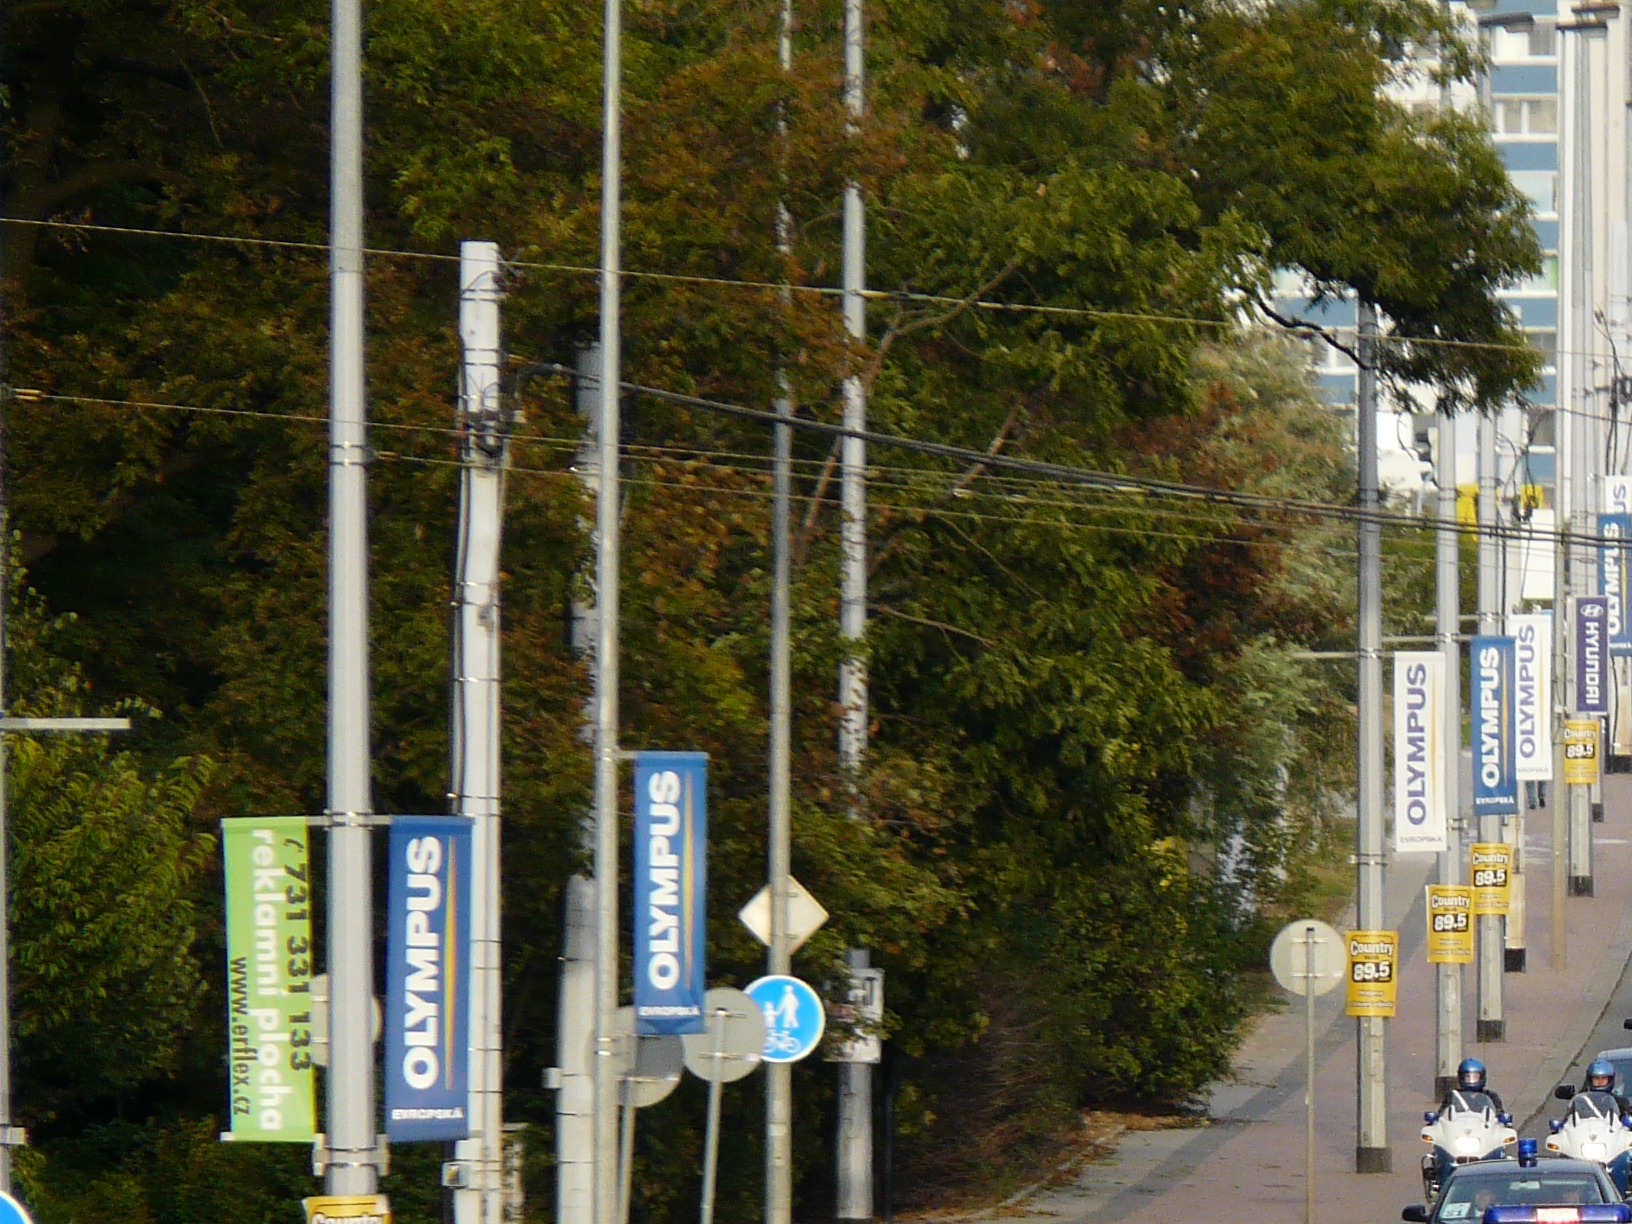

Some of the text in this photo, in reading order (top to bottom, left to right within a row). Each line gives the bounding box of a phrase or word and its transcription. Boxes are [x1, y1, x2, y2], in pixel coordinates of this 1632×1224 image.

[1479, 646, 1500, 788] OLYMPUS
[1518, 623, 1536, 759] OLYMPUS
[1585, 621, 1600, 704] HYUNDAI
[1407, 662, 1427, 826] OLYMPUS
[1567, 743, 1594, 758] 89.5
[648, 770, 681, 991] OLYMPUS
[1431, 894, 1470, 908] Country
[1472, 852, 1508, 864] Country
[1475, 869, 1506, 886] 89.5
[284, 864, 312, 1071] 731 331 133
[403, 836, 443, 1090] OLYMPUS
[1350, 940, 1394, 956] Country
[1353, 960, 1391, 982] 89.5
[1434, 913, 1467, 931] 89.5
[250, 828, 293, 1130] reklamní plocha
[230, 956, 258, 1115] www.erflex.cz
